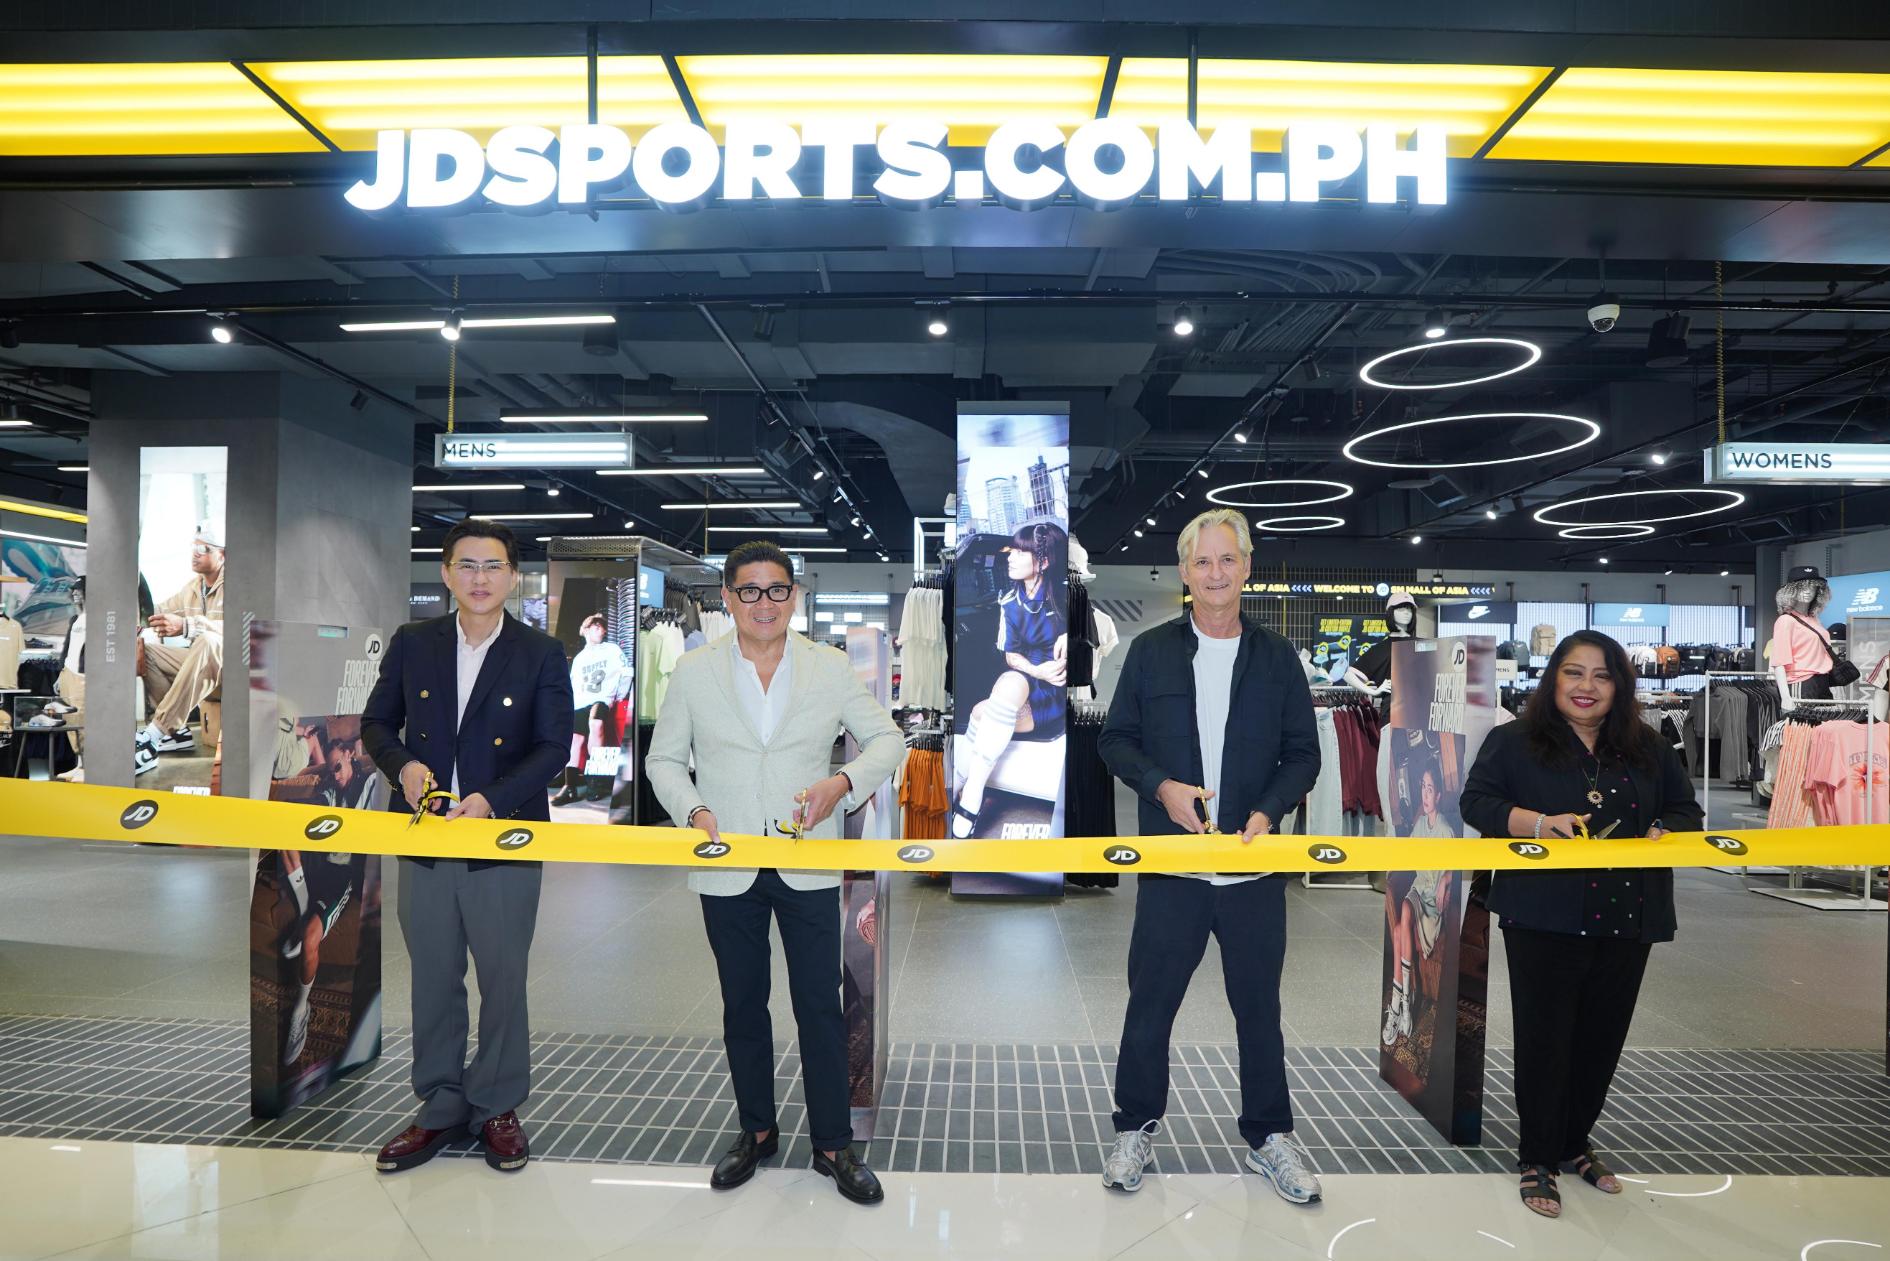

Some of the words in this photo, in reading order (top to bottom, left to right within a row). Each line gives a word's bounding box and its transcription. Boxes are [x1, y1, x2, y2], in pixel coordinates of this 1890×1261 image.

[343, 117, 1448, 211] JDSPORTS.COM.PH
[443, 443, 497, 458] MENS
[1732, 452, 1833, 469] WOMENS
[1253, 584, 1266, 592] OF
[1267, 584, 1290, 592] ASIA
[1314, 584, 1361, 593] WELCOME
[1361, 585, 1375, 593] TO
[1405, 586, 1431, 594] MALL
[1432, 586, 1446, 594] OF
[1446, 587, 1469, 595] ASIA
[106, 610, 117, 637] 1981
[105, 639, 116, 663] EST
[368, 640, 380, 654] JD
[1454, 649, 1465, 665] JD
[1434, 673, 1466, 703] FOREVER
[1428, 702, 1465, 733] FORWARD
[124, 806, 154, 820] JD
[308, 820, 339, 833] JD
[499, 832, 530, 845] JD
[1715, 838, 1740, 849] JD
[697, 844, 727, 854] JD
[902, 849, 930, 858] JD
[1110, 850, 1136, 861] JD
[1316, 849, 1341, 859] JD
[1519, 844, 1543, 854] JD
